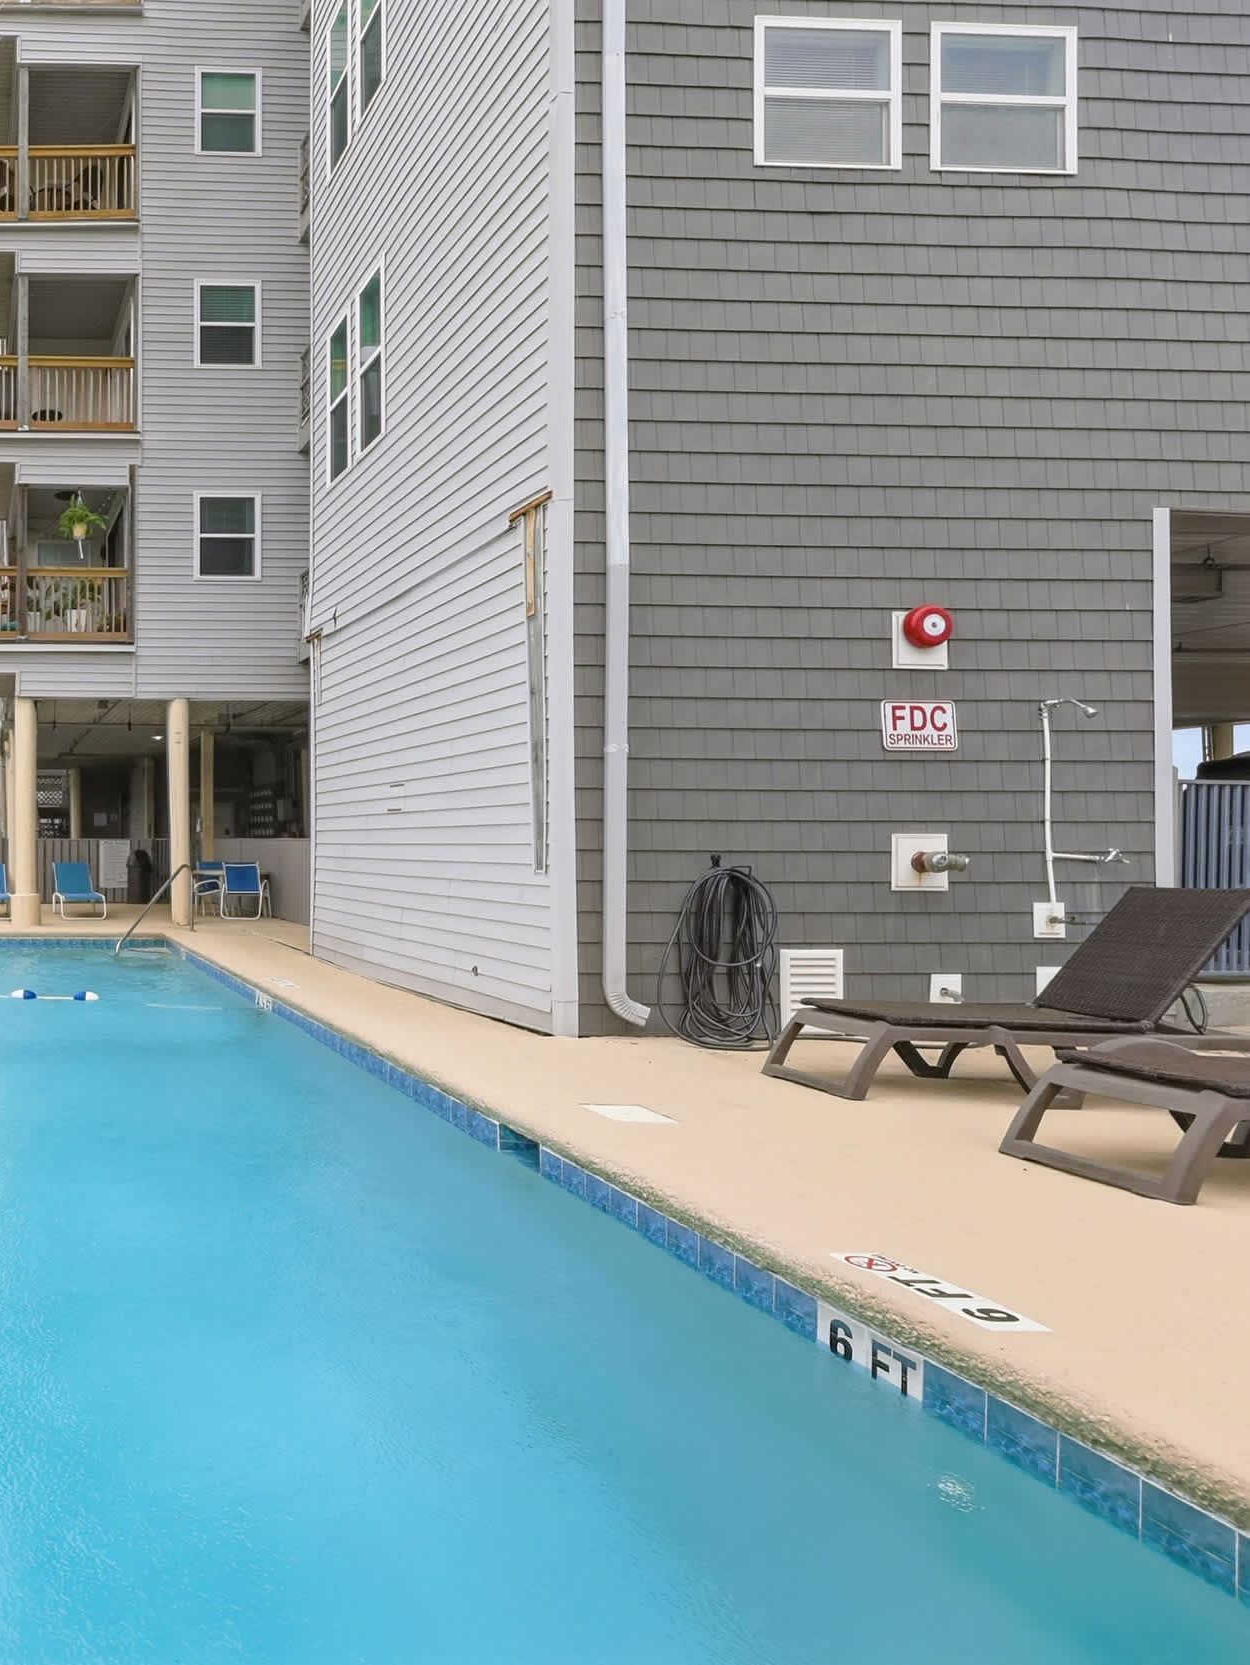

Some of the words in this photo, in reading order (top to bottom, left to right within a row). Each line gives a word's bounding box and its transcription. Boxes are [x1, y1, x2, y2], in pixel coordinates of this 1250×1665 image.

[891, 705, 948, 732] FDC
[888, 733, 953, 746] SPRINKLER
[887, 1276, 974, 1299] FT
[961, 1307, 1020, 1323] 6
[829, 1318, 854, 1361] 6
[871, 1338, 917, 1397] FT
